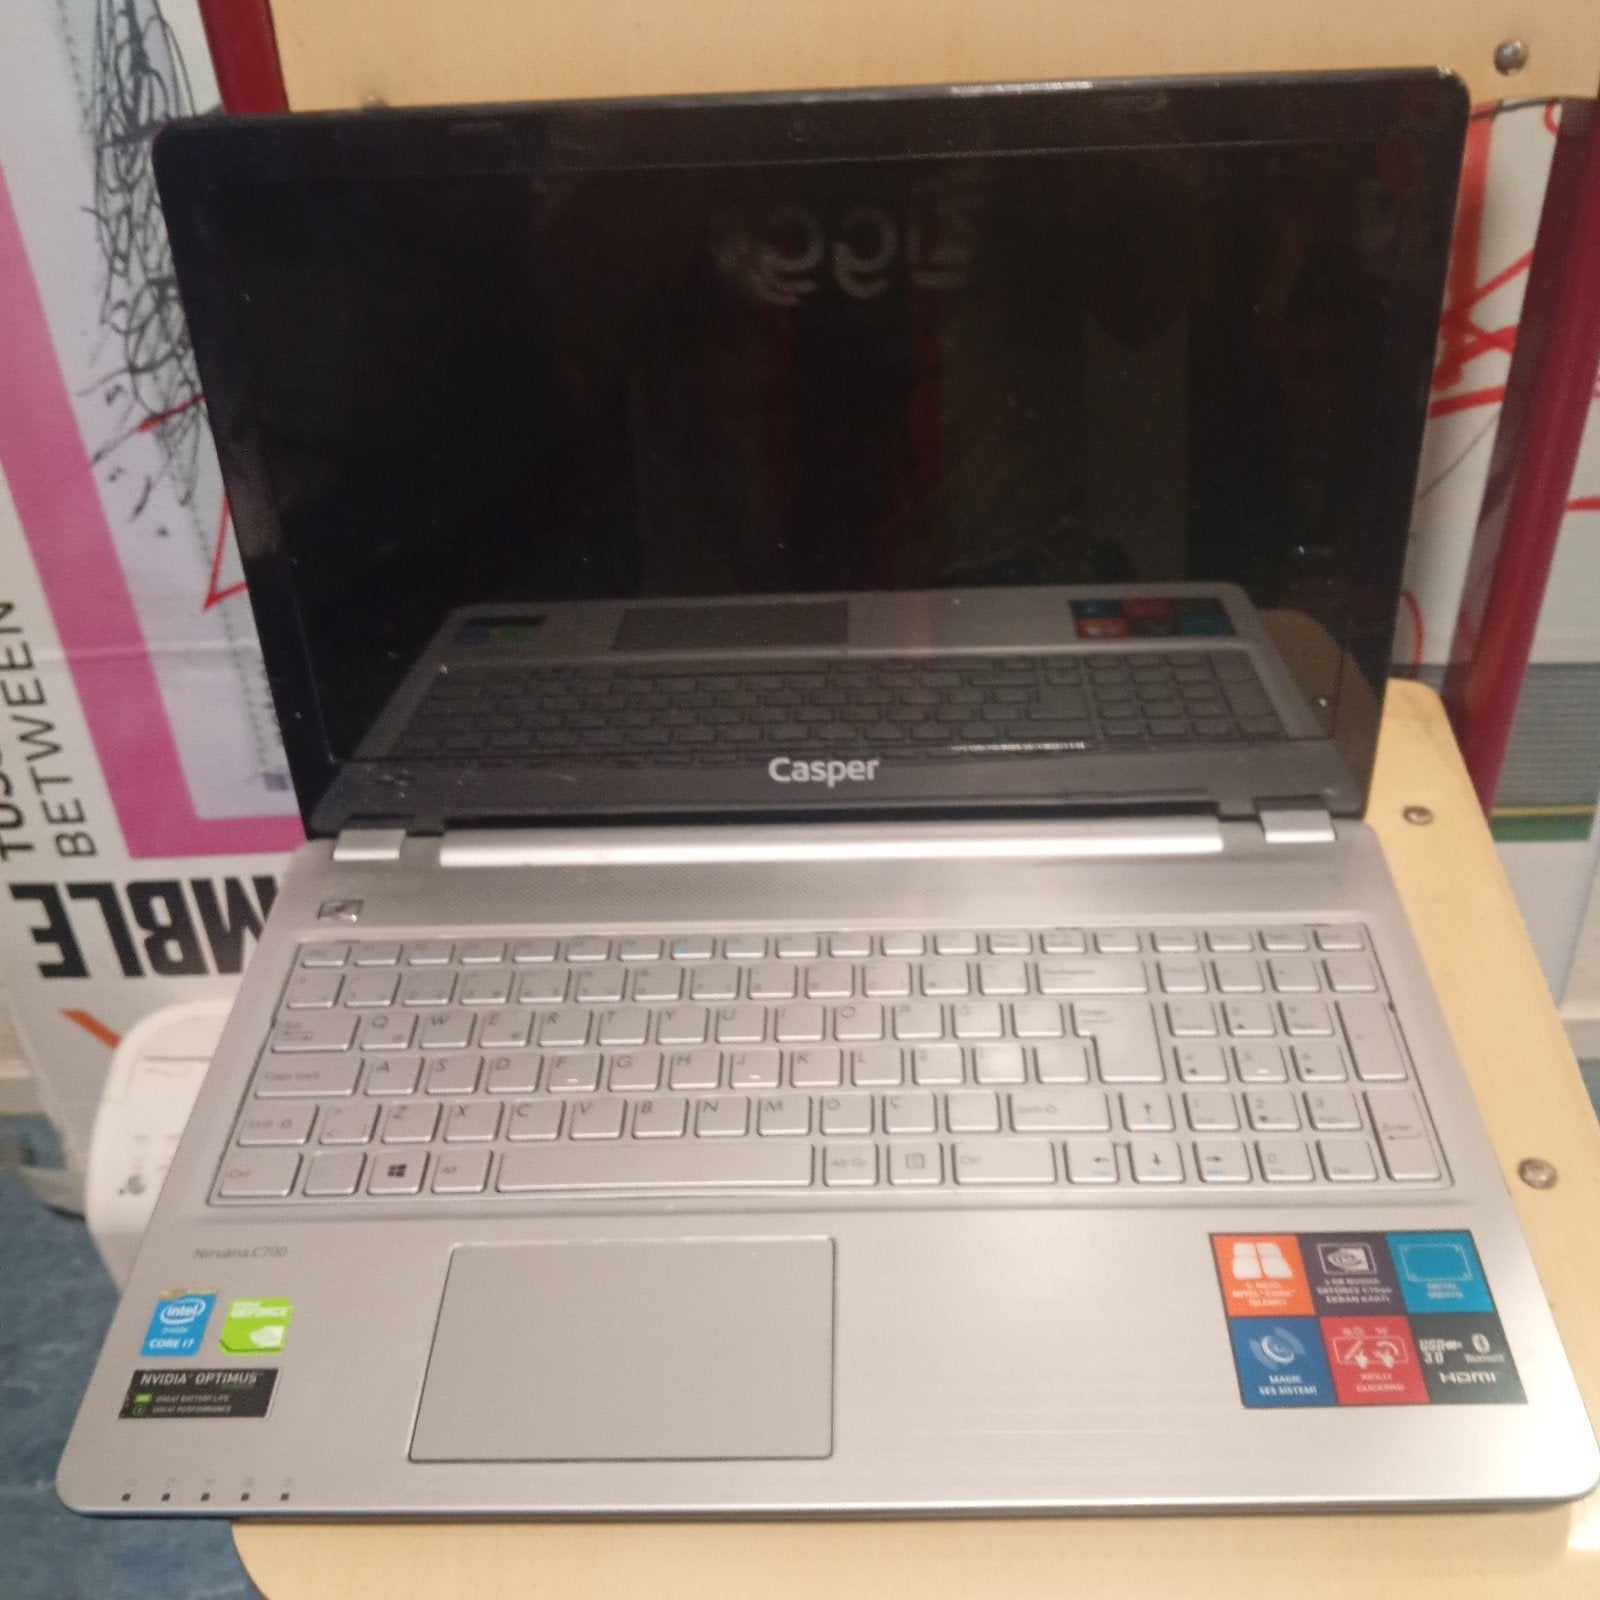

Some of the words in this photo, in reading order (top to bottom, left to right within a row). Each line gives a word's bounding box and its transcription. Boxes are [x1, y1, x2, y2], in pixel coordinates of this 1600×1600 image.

[768, 756, 880, 788] Casper
[140, 1373, 187, 1386] NVIDIA
[195, 1372, 257, 1386] OPTIMUS
